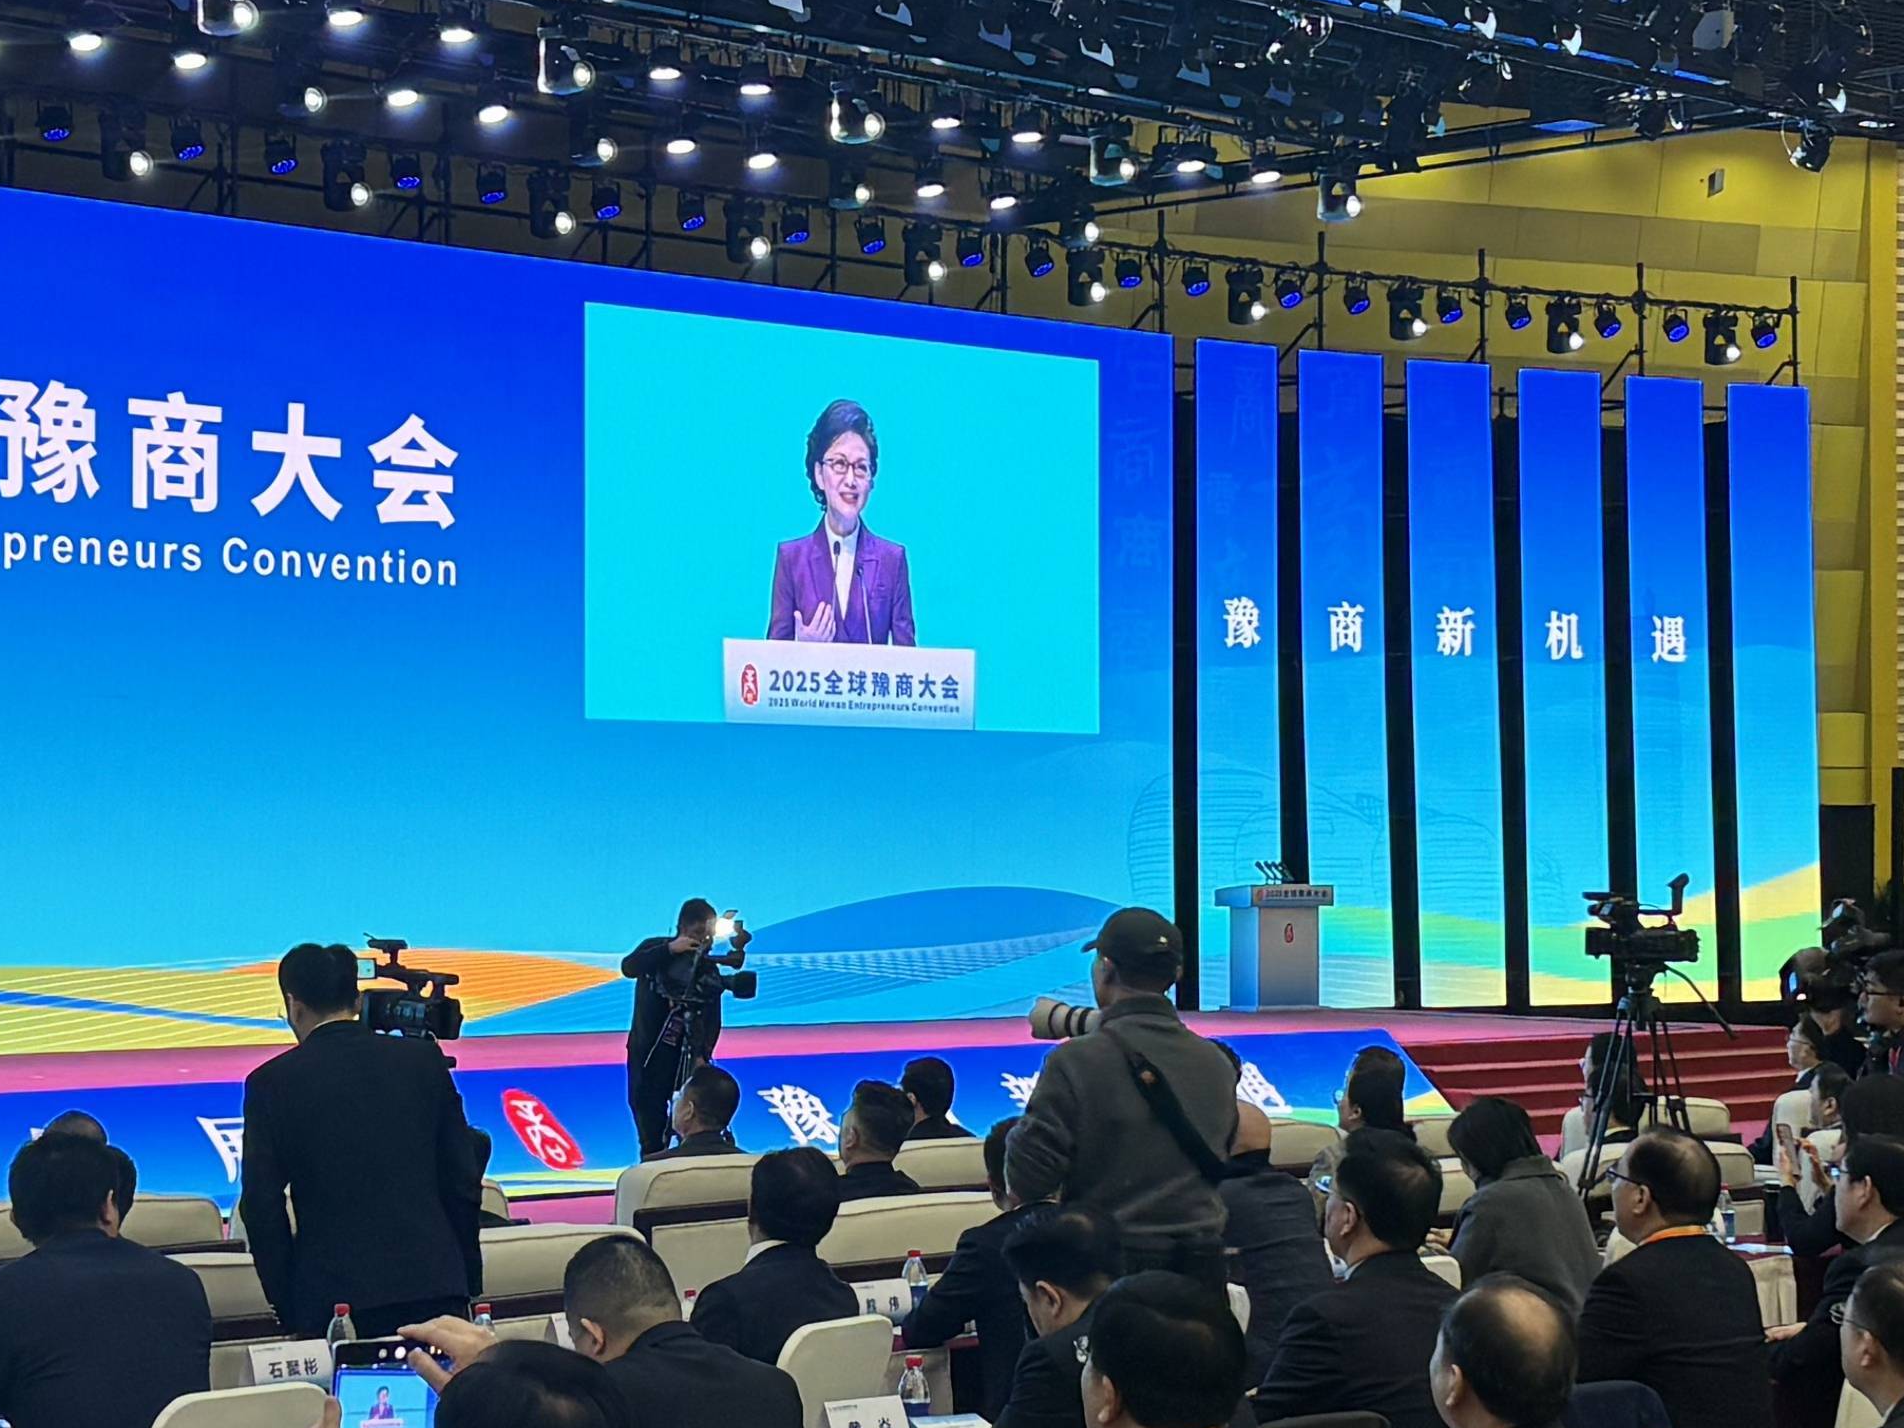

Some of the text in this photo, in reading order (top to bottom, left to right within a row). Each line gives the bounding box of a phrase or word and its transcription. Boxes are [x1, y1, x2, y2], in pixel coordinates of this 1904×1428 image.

[221, 537, 458, 587] Convention
[1222, 595, 1689, 664] 豫商新机遇
[768, 669, 960, 700] 2025全球豫商大会
